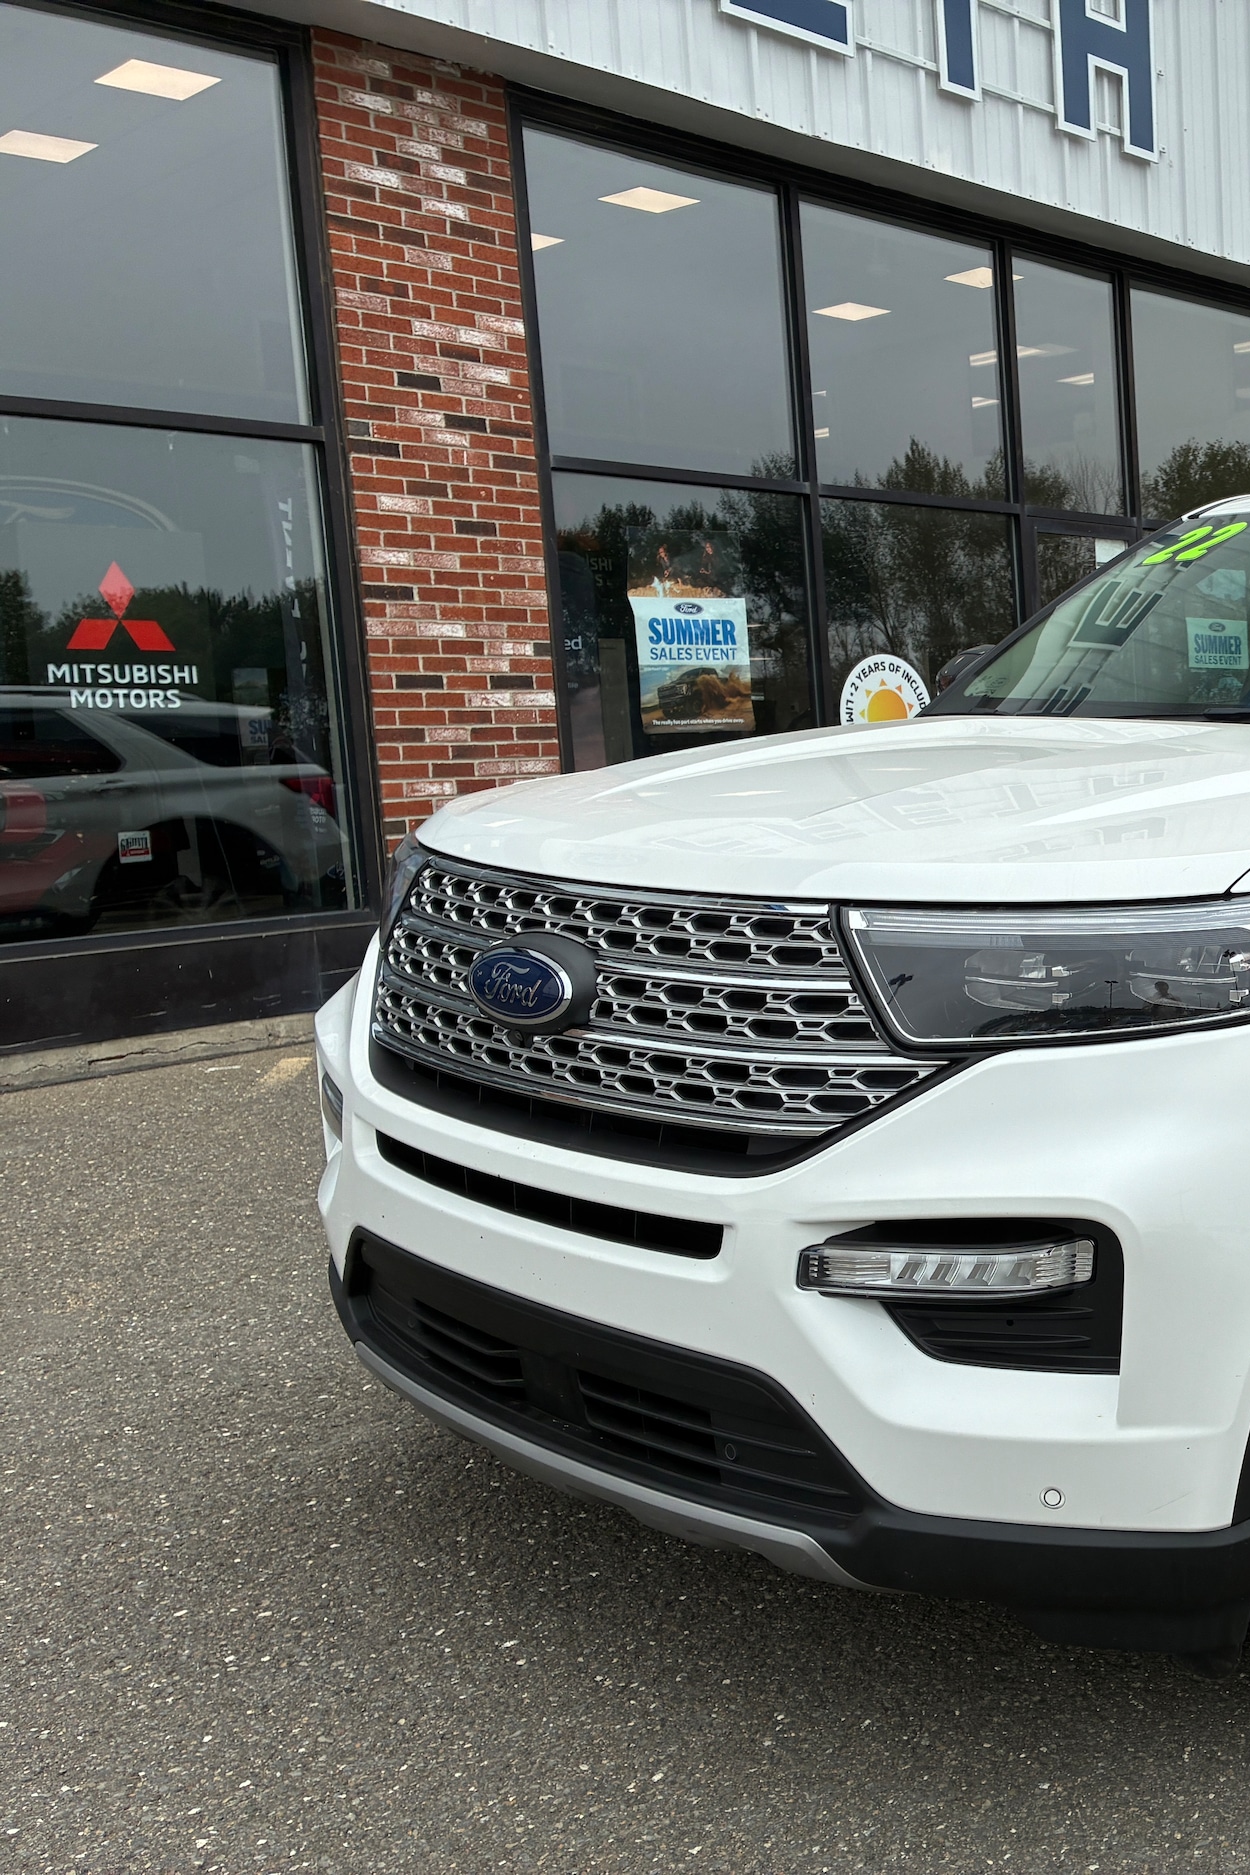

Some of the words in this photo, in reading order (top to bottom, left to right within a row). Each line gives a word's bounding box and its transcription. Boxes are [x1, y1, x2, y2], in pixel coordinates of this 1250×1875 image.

[1141, 521, 1248, 566] 22
[679, 603, 698, 614] Ford
[648, 617, 737, 646] SUMMER
[650, 647, 693, 661] SALES
[696, 647, 737, 661] EVENT
[1194, 633, 1242, 655] SUMMER
[1194, 655, 1218, 665] SALES
[1219, 655, 1242, 665] EVENT
[47, 663, 199, 685] MITSUBISHI
[850, 682, 859, 693] 2
[855, 661, 886, 683] YEARS
[888, 662, 902, 675] OF
[69, 688, 182, 709] MOTORS
[845, 699, 855, 724] LIM
[484, 961, 543, 1008] Ford
